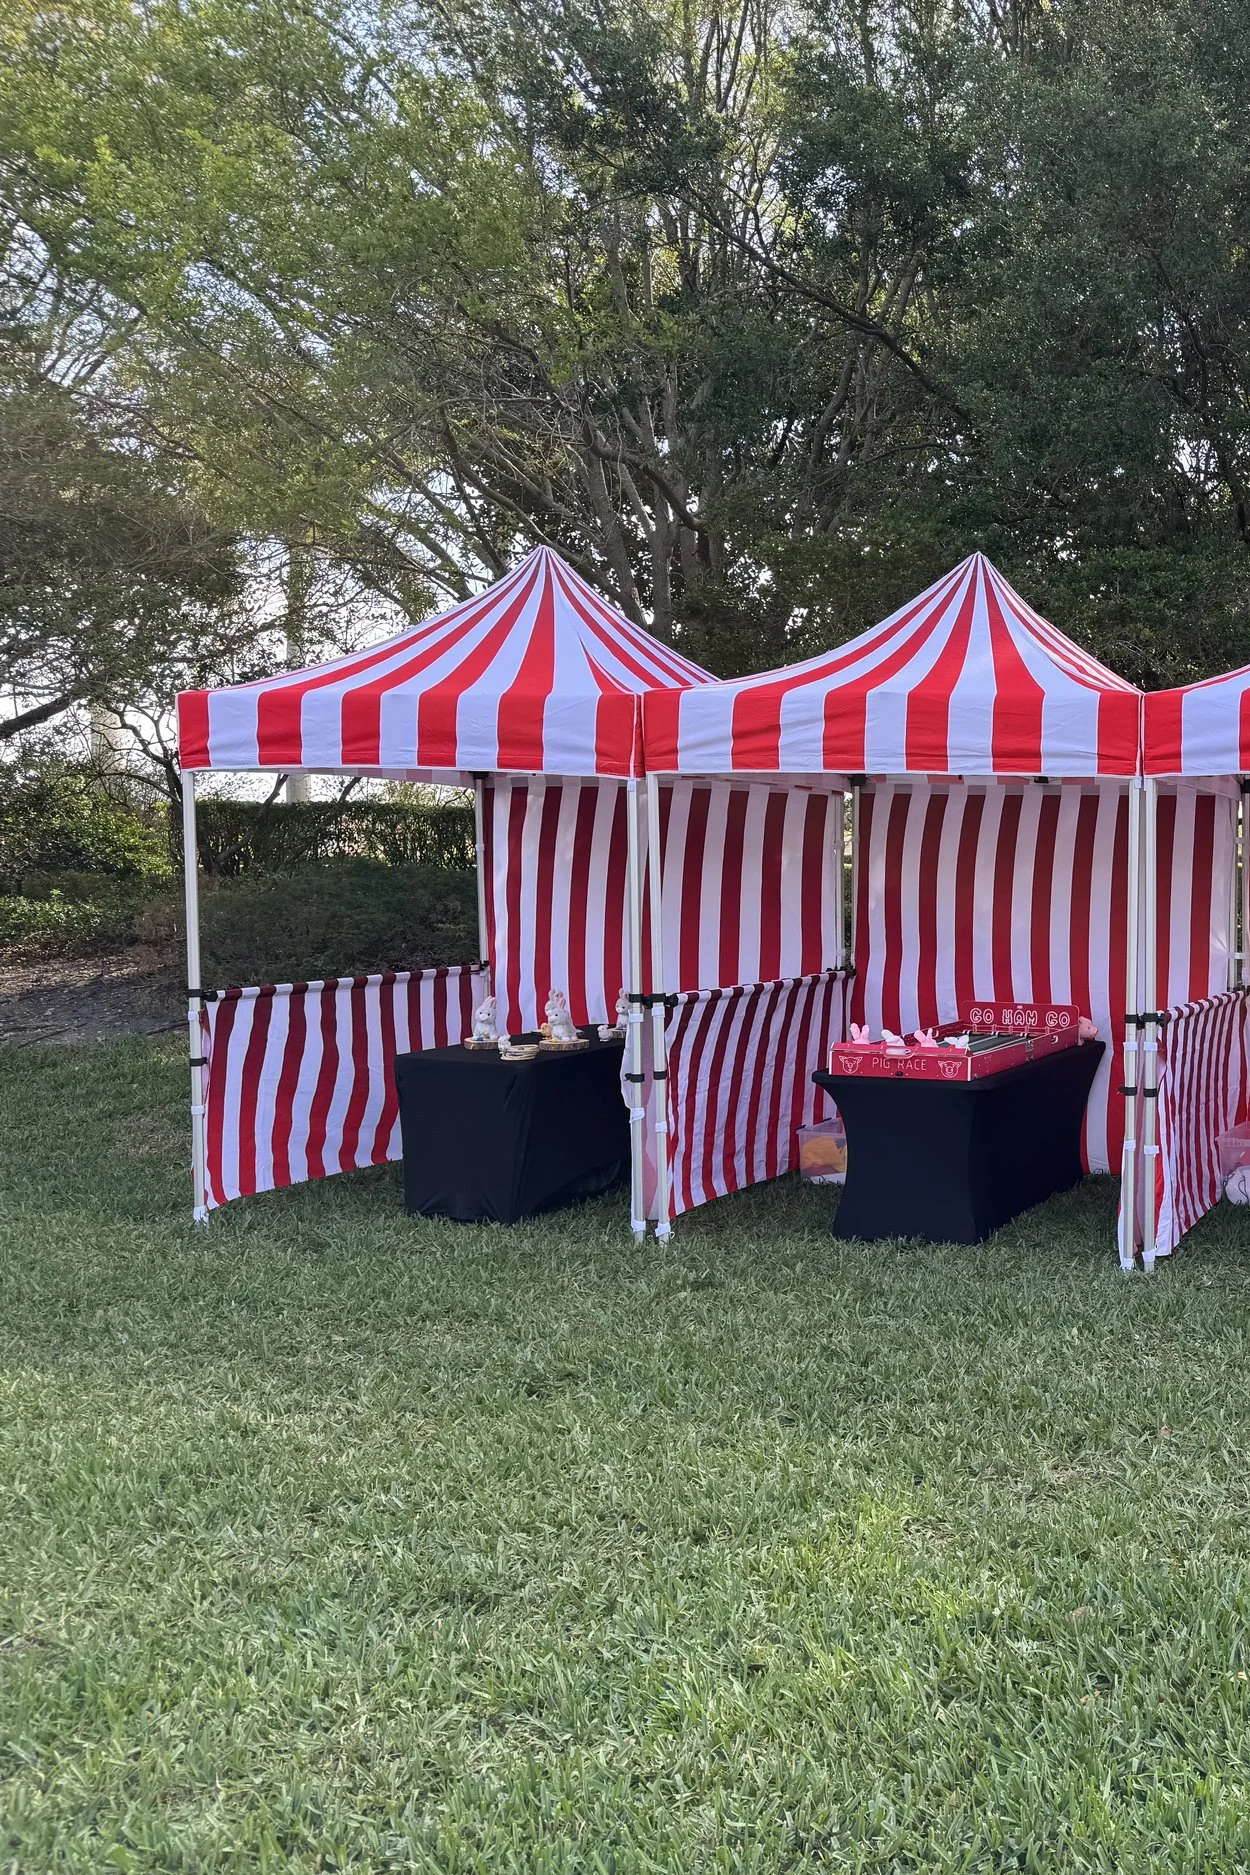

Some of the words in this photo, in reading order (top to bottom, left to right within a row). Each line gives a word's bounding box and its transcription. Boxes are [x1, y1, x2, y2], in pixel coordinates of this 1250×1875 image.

[970, 1008, 994, 1024] GO
[1002, 1009, 1038, 1026] HAM
[1045, 1011, 1070, 1027] GO
[872, 1057, 890, 1069] PIG
[897, 1059, 927, 1071] RACE
